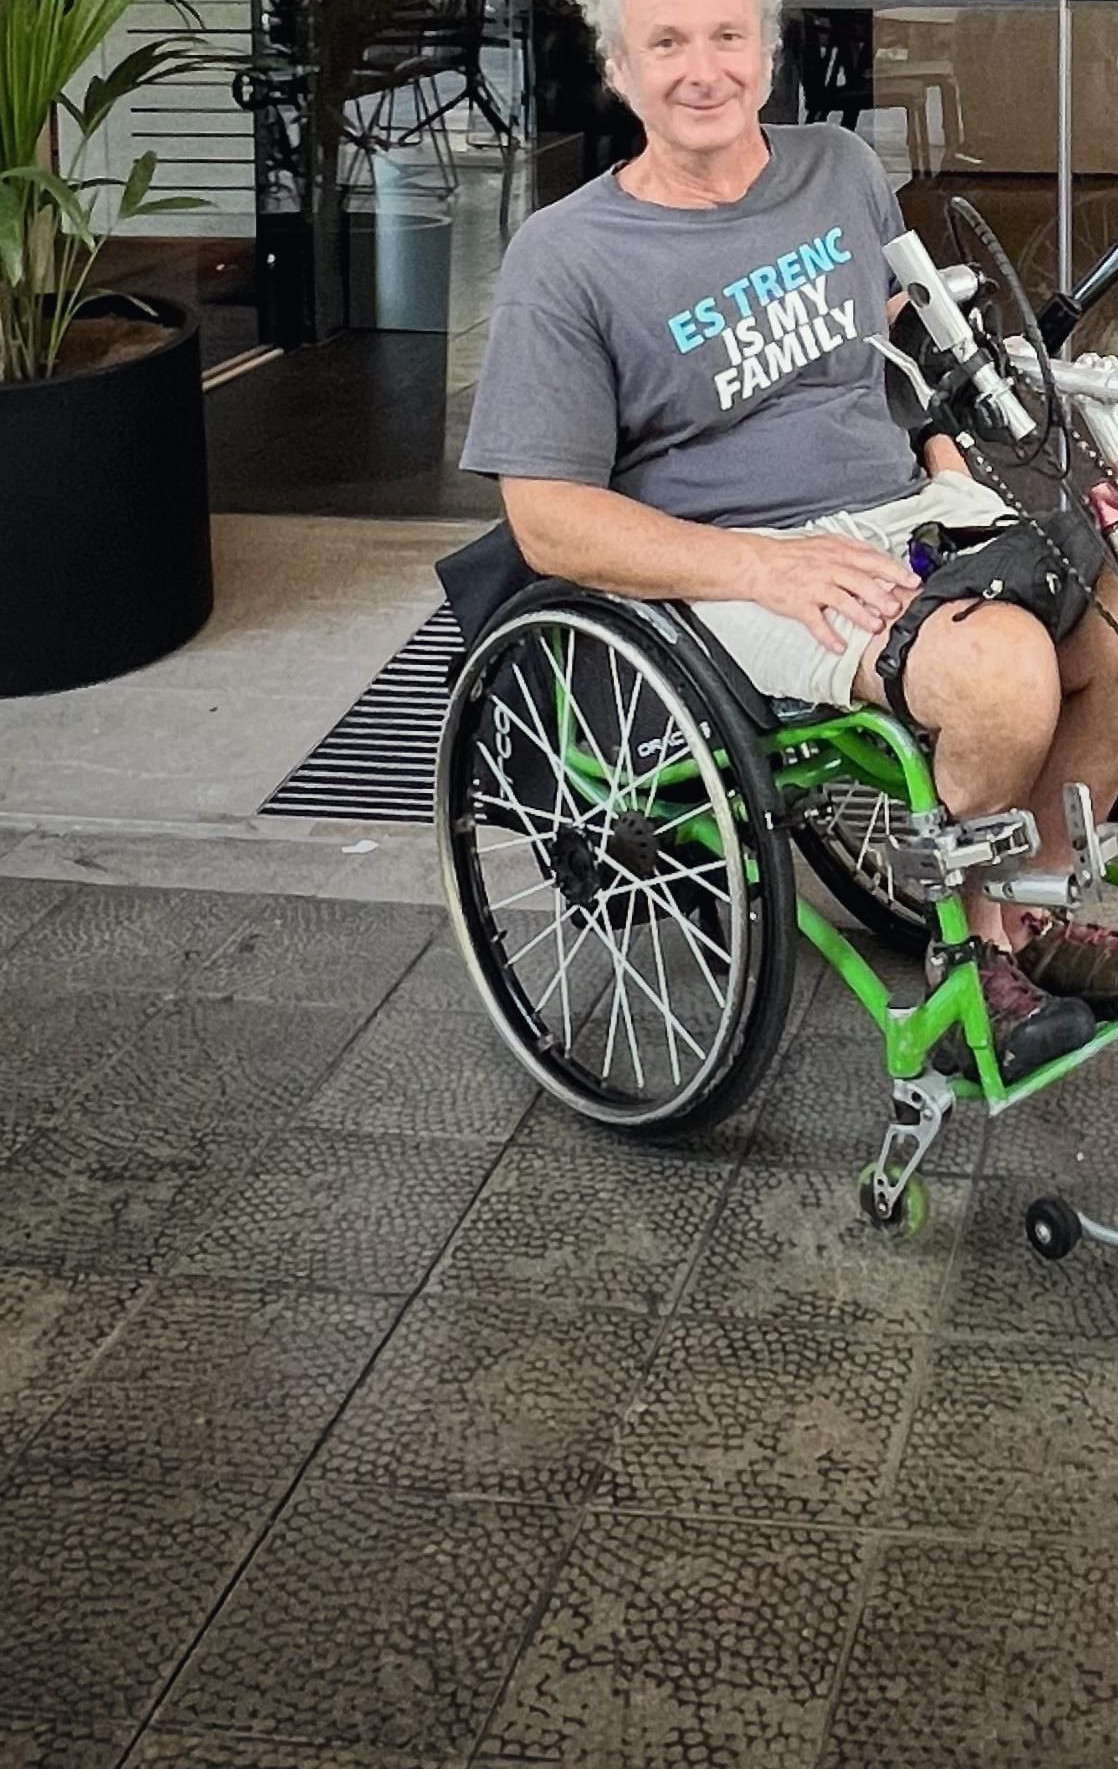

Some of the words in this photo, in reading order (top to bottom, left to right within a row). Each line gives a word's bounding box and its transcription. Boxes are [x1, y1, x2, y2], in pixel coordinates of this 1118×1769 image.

[667, 296, 726, 354] ES
[723, 227, 852, 318] TRENC
[721, 316, 765, 367] IS
[766, 274, 830, 341] MY
[713, 299, 858, 412] FAMILY
